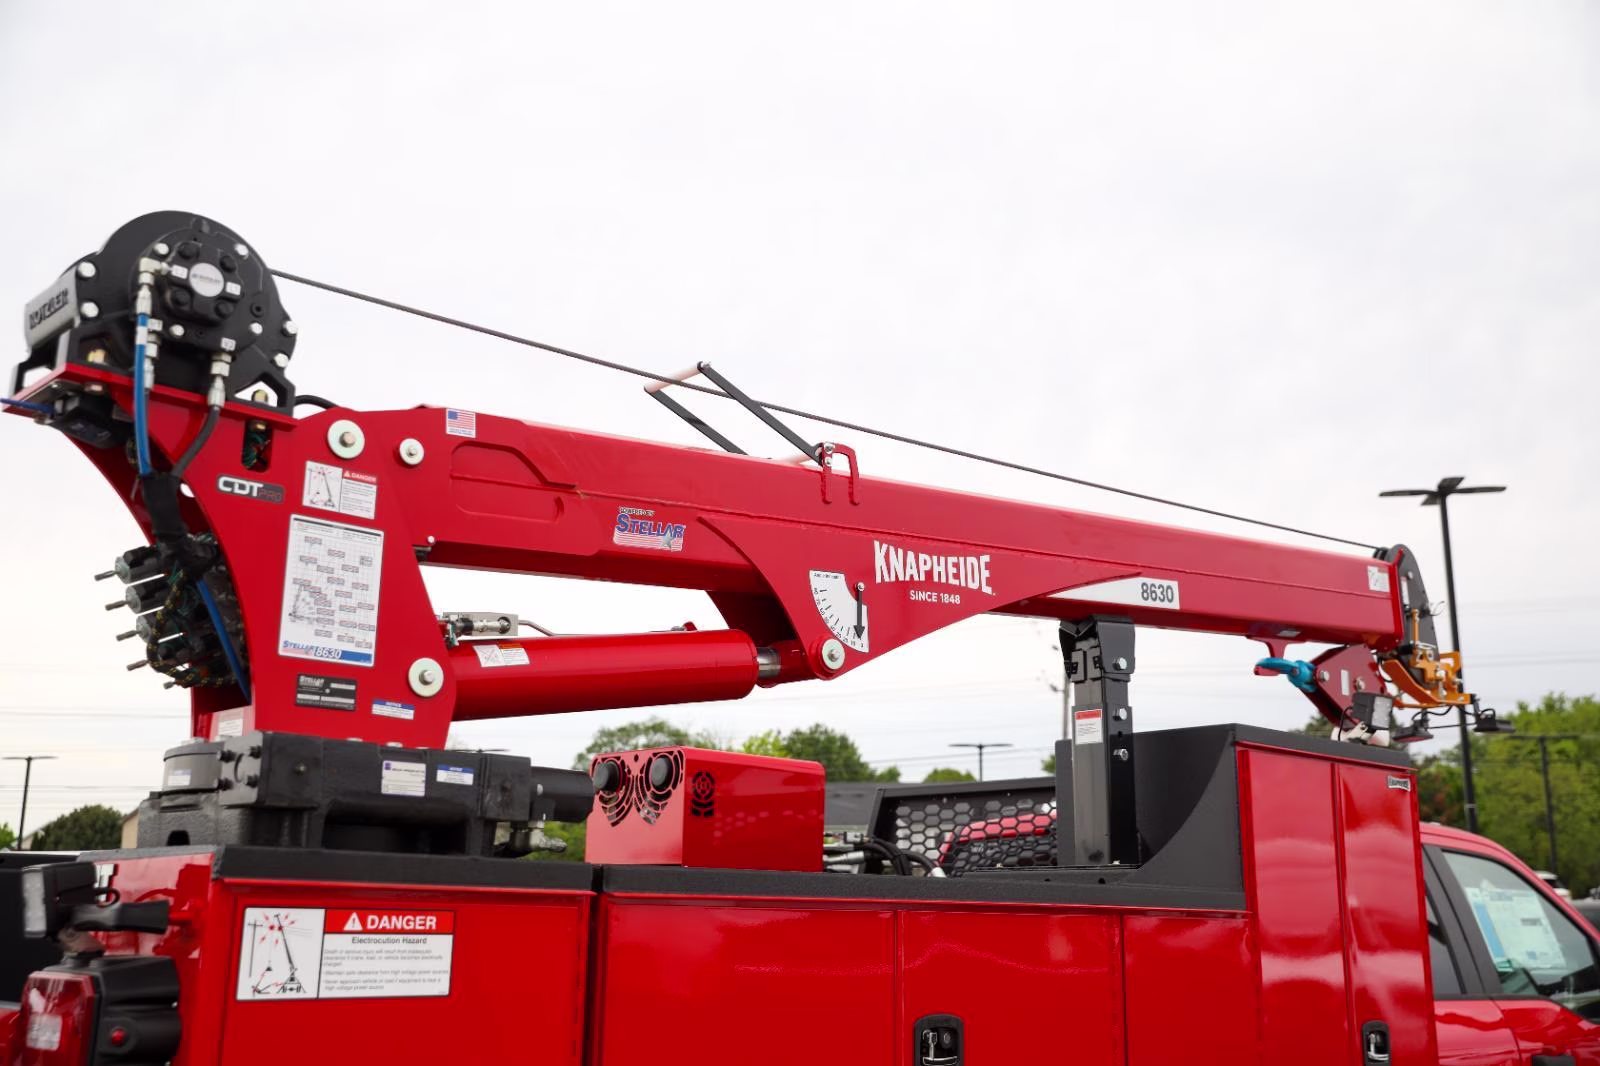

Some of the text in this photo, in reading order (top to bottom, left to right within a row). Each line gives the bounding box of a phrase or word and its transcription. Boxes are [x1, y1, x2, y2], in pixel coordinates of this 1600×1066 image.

[218, 476, 264, 497] CDT
[616, 513, 685, 539] STELLAR
[873, 540, 993, 595] KNAPHEIDE
[909, 589, 961, 604] SINCE 1848
[1141, 582, 1174, 603] 8630
[283, 640, 342, 660] STELLAR 8630
[366, 915, 437, 930] DANGER
[351, 936, 428, 945] Electrocution Hazard
